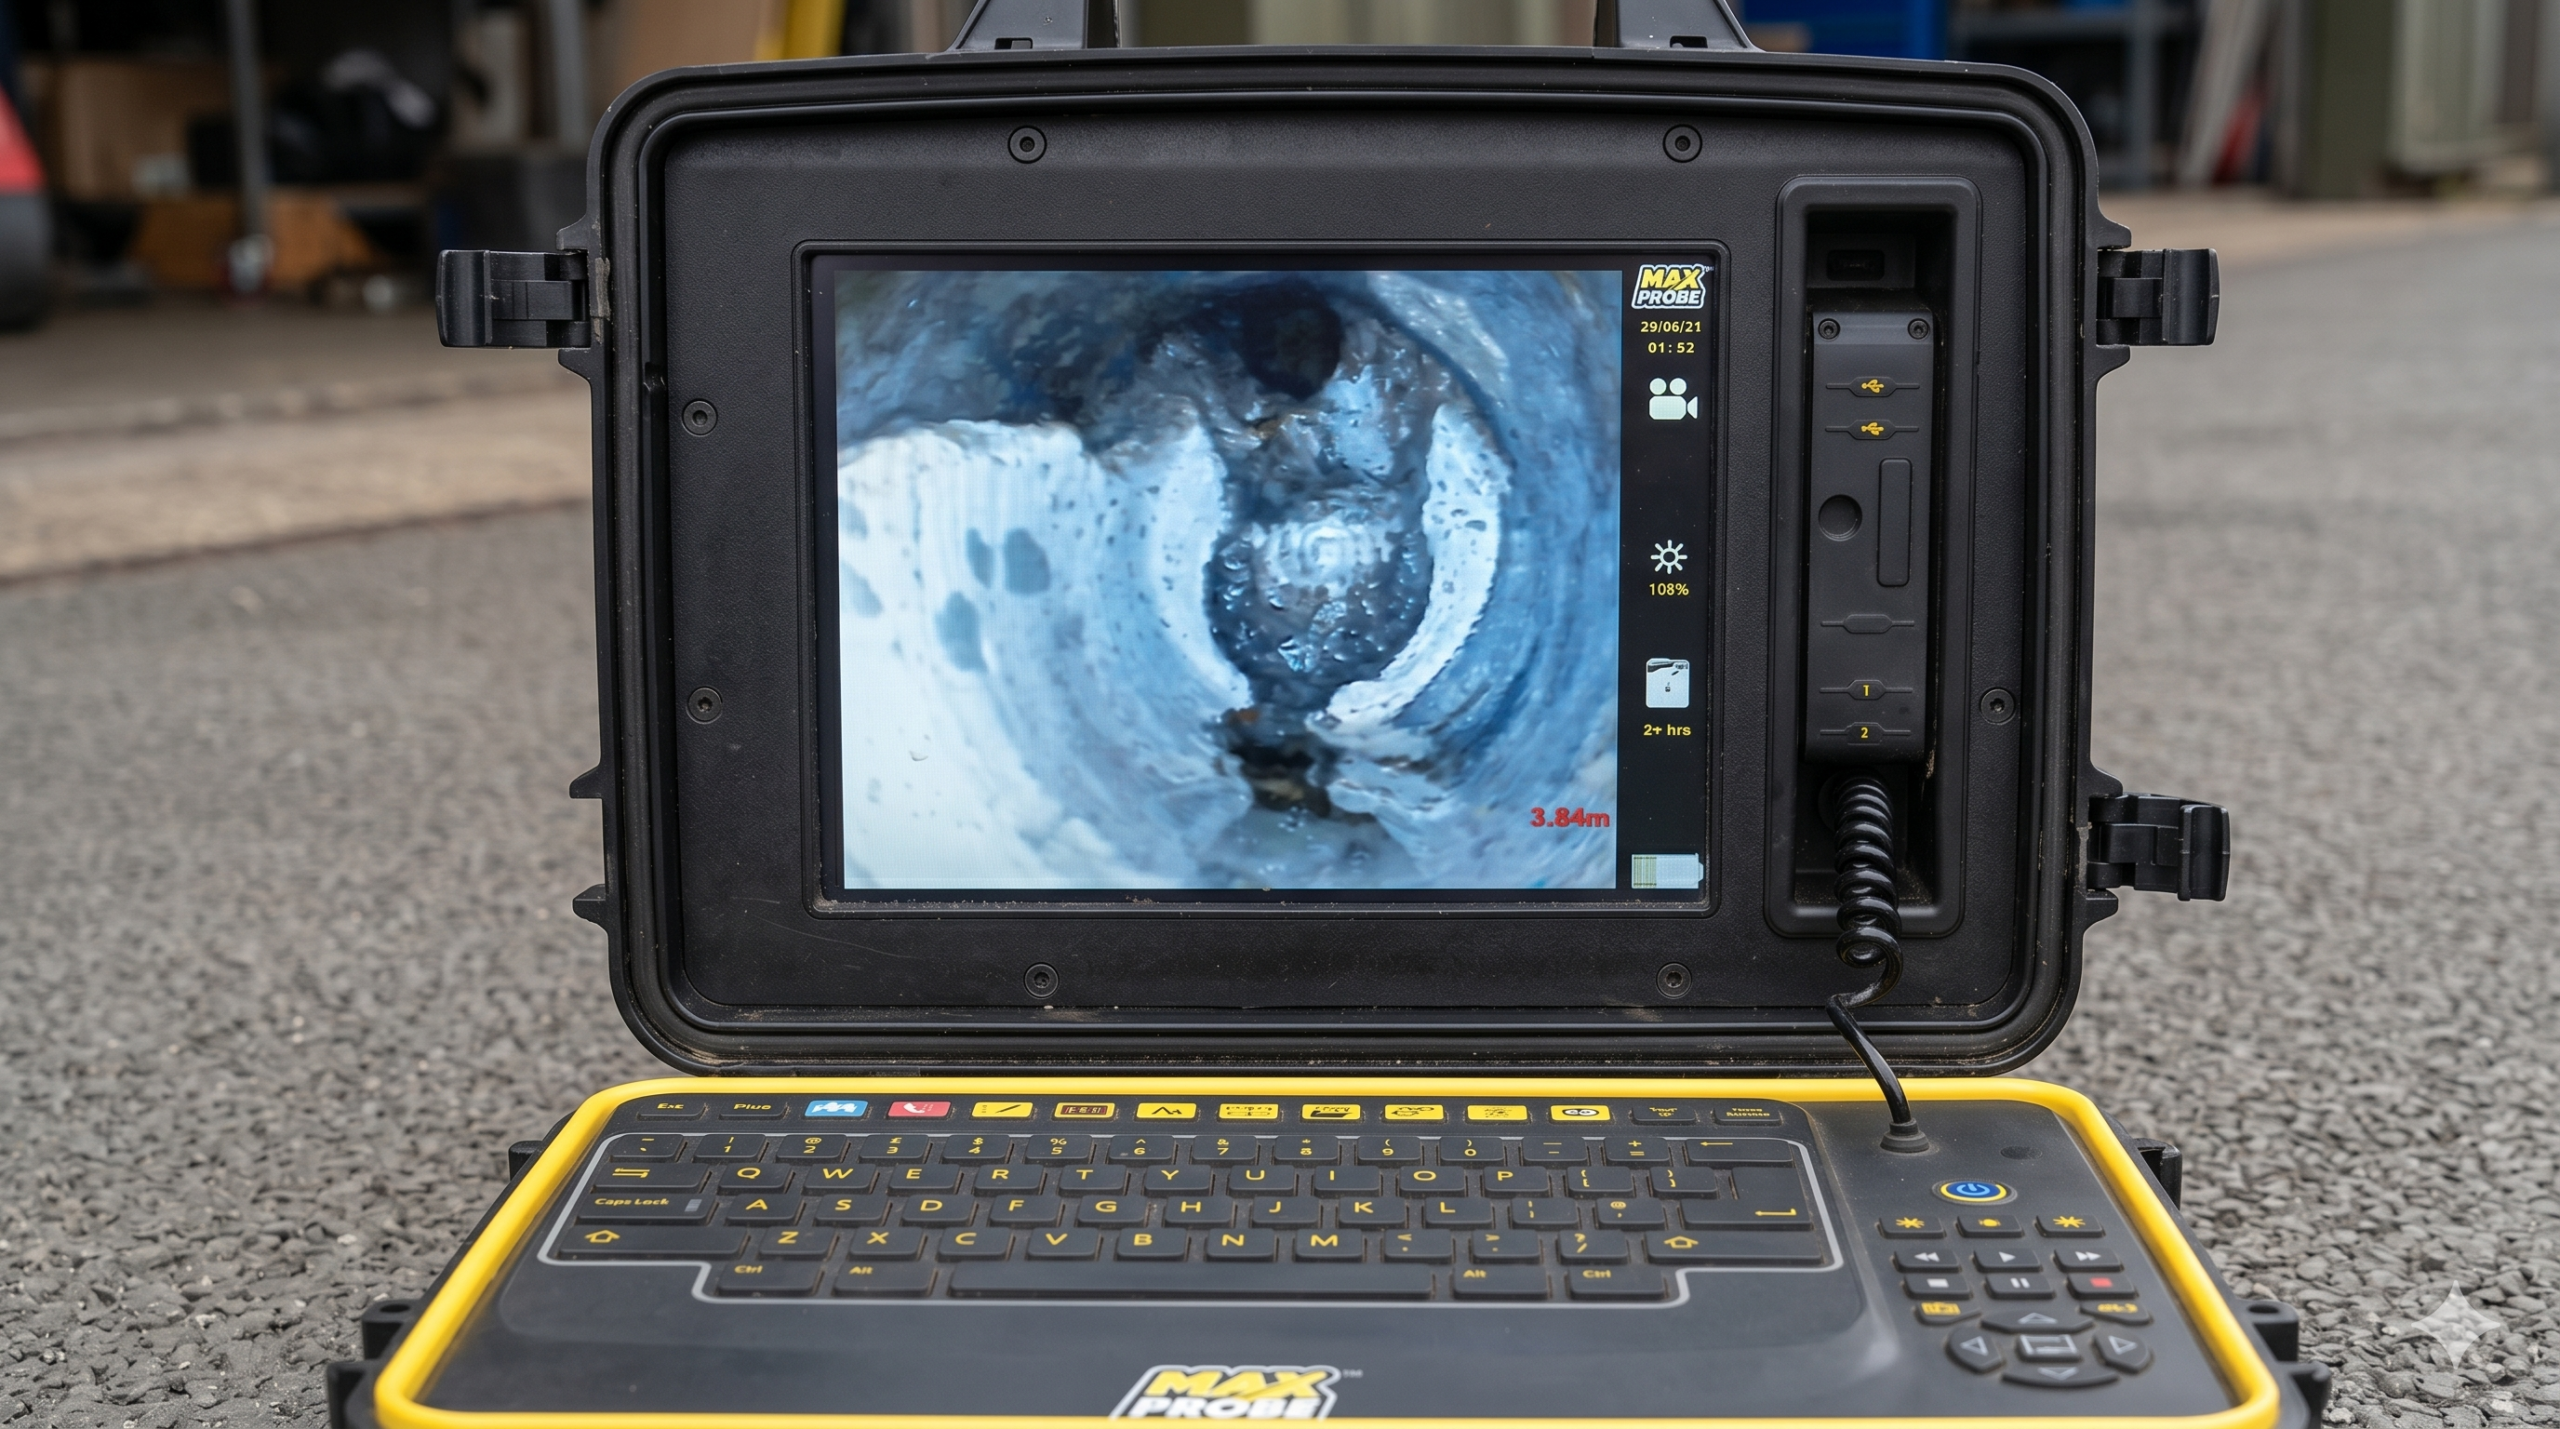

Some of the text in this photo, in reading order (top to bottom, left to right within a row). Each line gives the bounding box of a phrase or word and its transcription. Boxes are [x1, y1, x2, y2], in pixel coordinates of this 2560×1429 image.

[1640, 268, 1701, 291] MAX
[1636, 289, 1702, 305] PROBE
[1640, 321, 1702, 333] 29/06/21
[1648, 582, 1690, 596] 108%
[1643, 723, 1692, 737] 2+ hrs
[1860, 726, 1869, 739] 2
[1530, 807, 1610, 828] 3.84m
[803, 1145, 817, 1154] 2
[886, 1146, 899, 1154] 3
[968, 1146, 982, 1154] 4
[1051, 1146, 1063, 1155] 5
[1133, 1147, 1146, 1156] 6
[1217, 1147, 1230, 1156] 7
[1381, 1147, 1394, 1156] 9
[737, 1167, 761, 1180] Q
[822, 1168, 854, 1180] W
[906, 1168, 922, 1180] E
[991, 1168, 1010, 1180] R
[1076, 1169, 1093, 1180] T
[1160, 1169, 1180, 1181] Y
[1245, 1169, 1266, 1181] U
[1497, 1170, 1514, 1181] P
[745, 1198, 769, 1211] A
[835, 1199, 852, 1211] S
[920, 1200, 943, 1212] D
[1008, 1200, 1024, 1212] F
[1095, 1200, 1117, 1213] G
[1180, 1201, 1202, 1213] H
[1269, 1201, 1282, 1213] J
[1353, 1201, 1373, 1213] K
[1440, 1201, 1456, 1213] L
[777, 1231, 799, 1244] Z
[867, 1232, 890, 1244] X
[955, 1232, 976, 1245] C
[1045, 1233, 1069, 1246] V
[1133, 1233, 1153, 1246] B
[1221, 1234, 1245, 1247] N
[1309, 1234, 1340, 1247] M
[1463, 1269, 1487, 1278] Alt
[1144, 1370, 1328, 1399] MAX
[1127, 1396, 1322, 1419] PROBE
